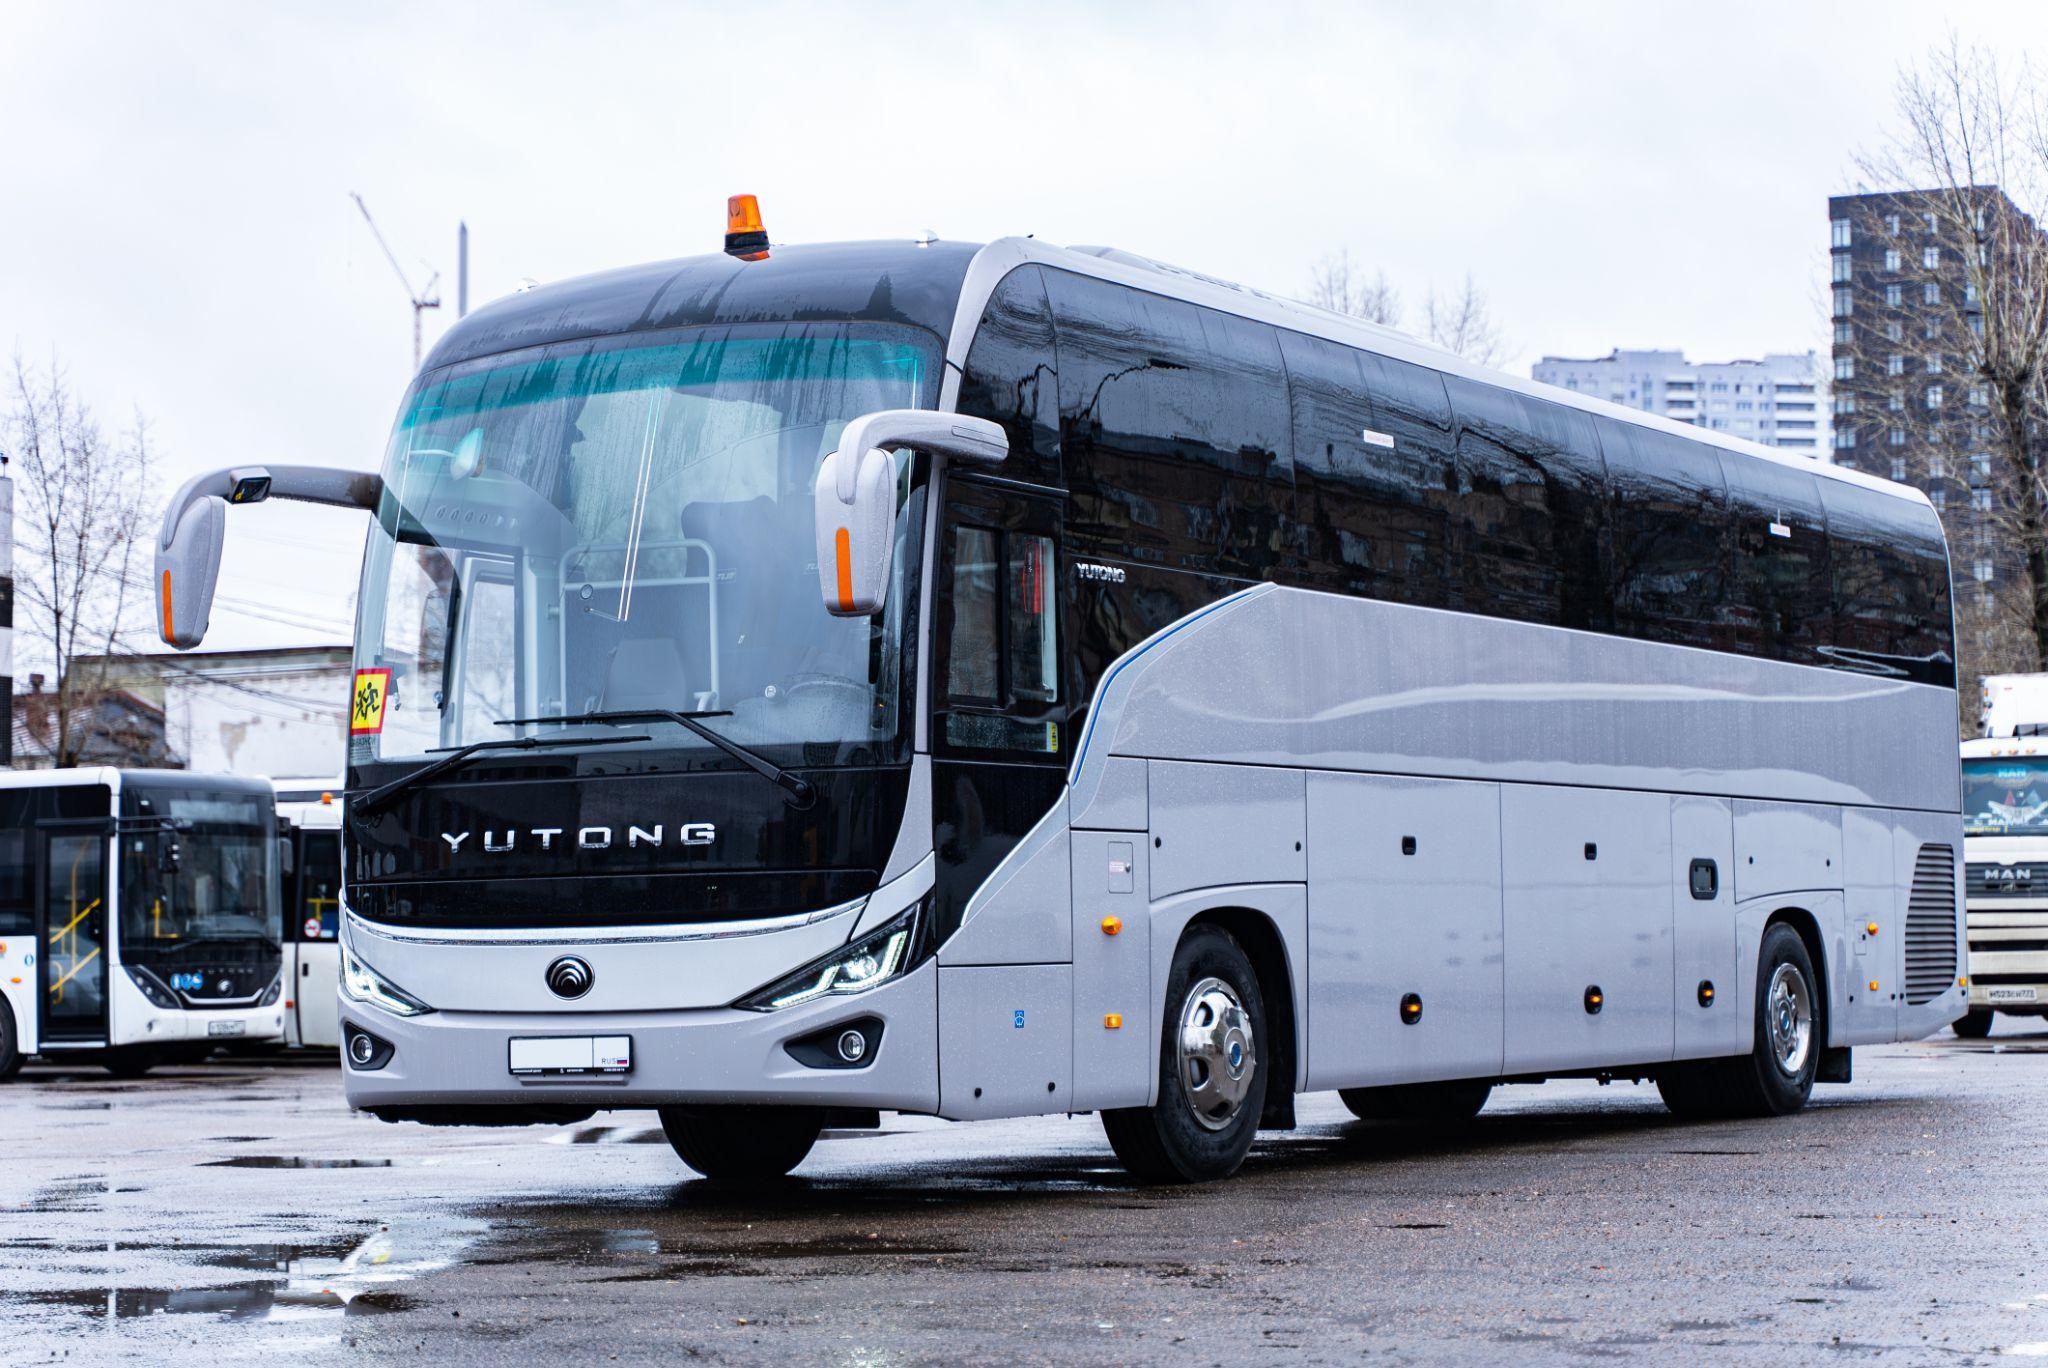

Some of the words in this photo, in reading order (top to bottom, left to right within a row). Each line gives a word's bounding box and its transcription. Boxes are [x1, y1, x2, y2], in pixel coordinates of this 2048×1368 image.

[1075, 563, 1126, 583] YUTONG
[441, 823, 716, 853] YUTONG
[1984, 869, 2031, 880] MAN
[601, 1057, 616, 1065] RUS
